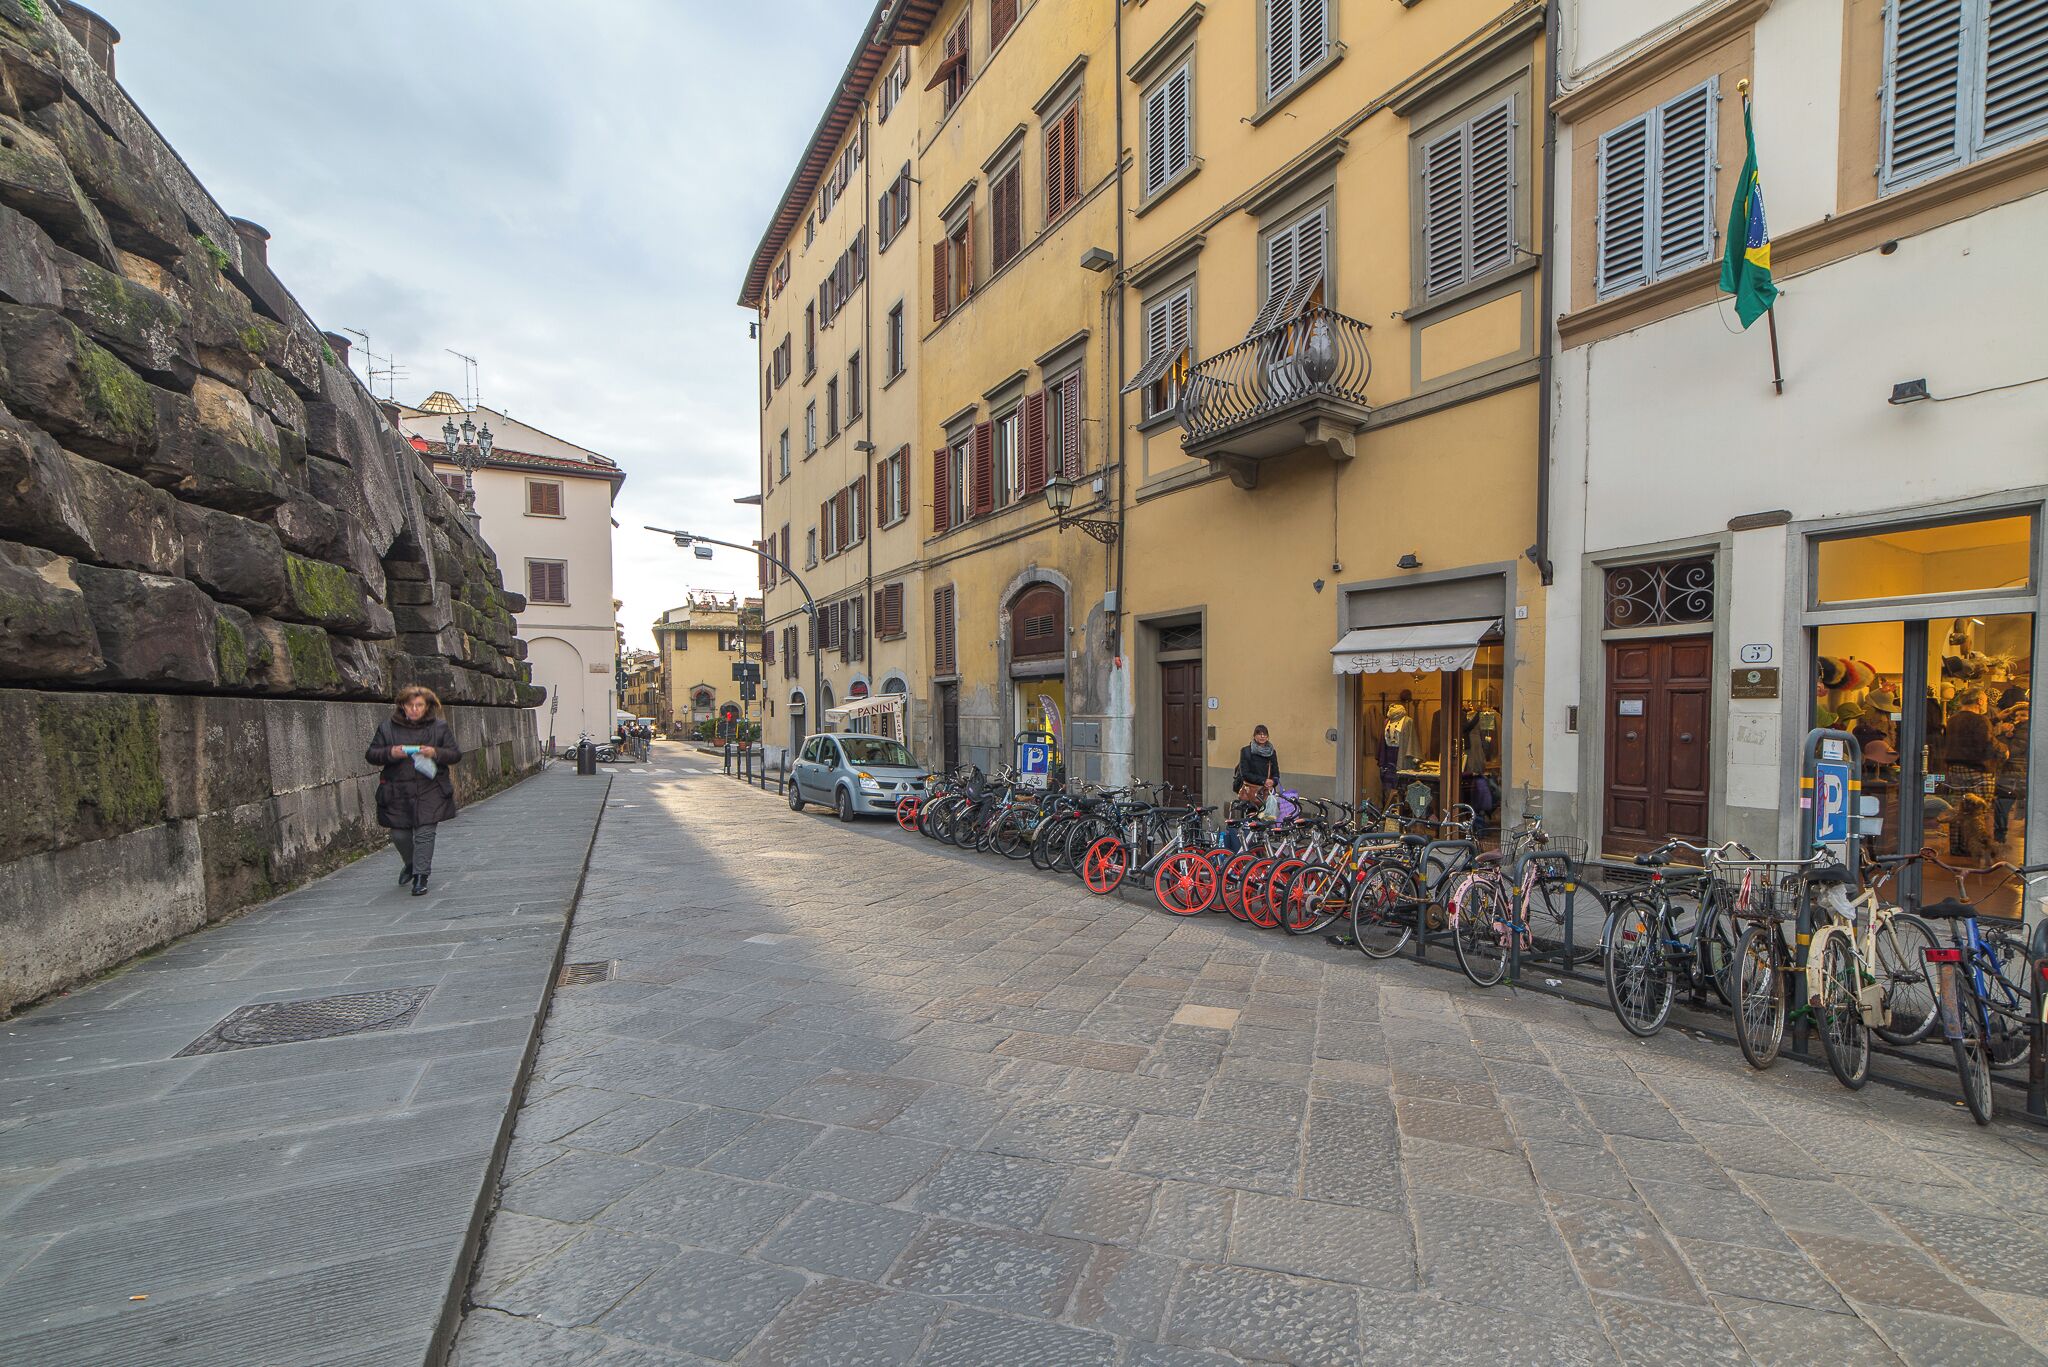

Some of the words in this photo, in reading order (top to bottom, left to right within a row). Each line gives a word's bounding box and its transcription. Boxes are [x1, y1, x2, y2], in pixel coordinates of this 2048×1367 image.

[1352, 654, 1381, 670] Stile
[1391, 650, 1456, 668] biologico
[857, 702, 894, 717] PANINI
[1027, 747, 1044, 771] P
[1820, 774, 1843, 837] P
